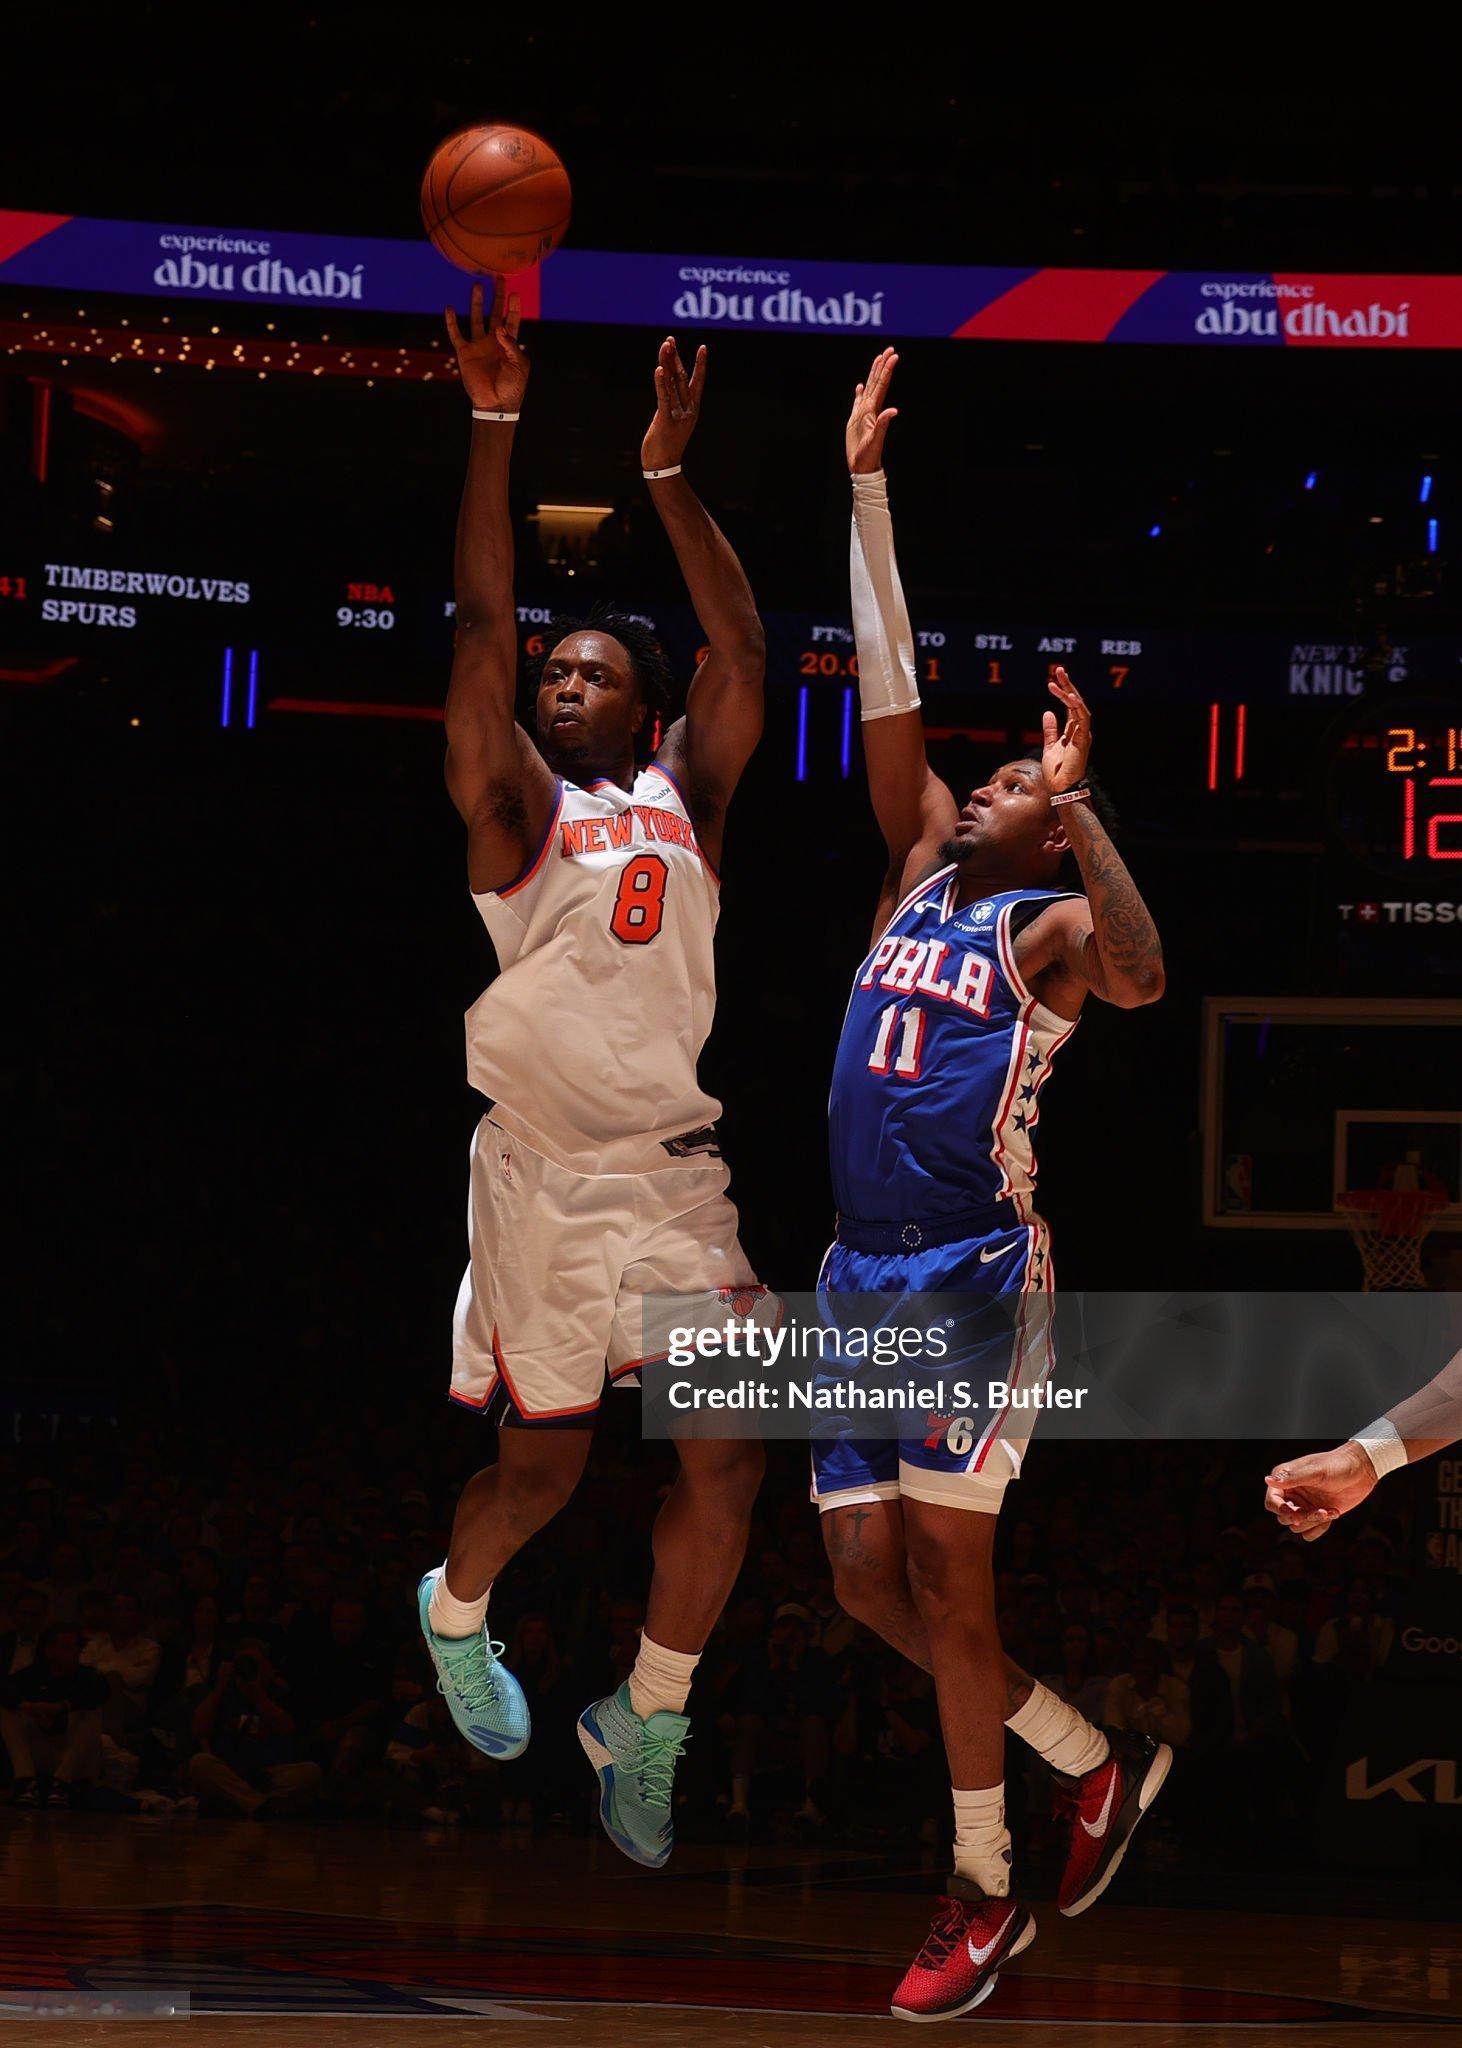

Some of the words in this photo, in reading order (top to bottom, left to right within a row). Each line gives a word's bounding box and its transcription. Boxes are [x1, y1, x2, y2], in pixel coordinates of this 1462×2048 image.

[153, 253, 234, 291] abu
[673, 285, 754, 321] abu
[1195, 300, 1278, 336] abu
[45, 564, 250, 604] TIMBERWOLVES
[347, 583, 395, 603] NBA
[42, 599, 137, 628] SPURS
[336, 607, 395, 630] 9:30
[974, 634, 1012, 650] STL
[1038, 637, 1077, 654] AST
[1101, 640, 1142, 656] REB
[927, 659, 942, 681] 1
[988, 661, 1002, 684] 1
[1110, 666, 1129, 689] 7
[561, 808, 633, 858] NEW
[632, 805, 701, 857] YORK
[609, 853, 669, 945] 8
[1382, 902, 1462, 924] TISS
[860, 935, 996, 1020] PHLA
[868, 1004, 927, 1080] 11
[924, 1409, 975, 1455] 76
